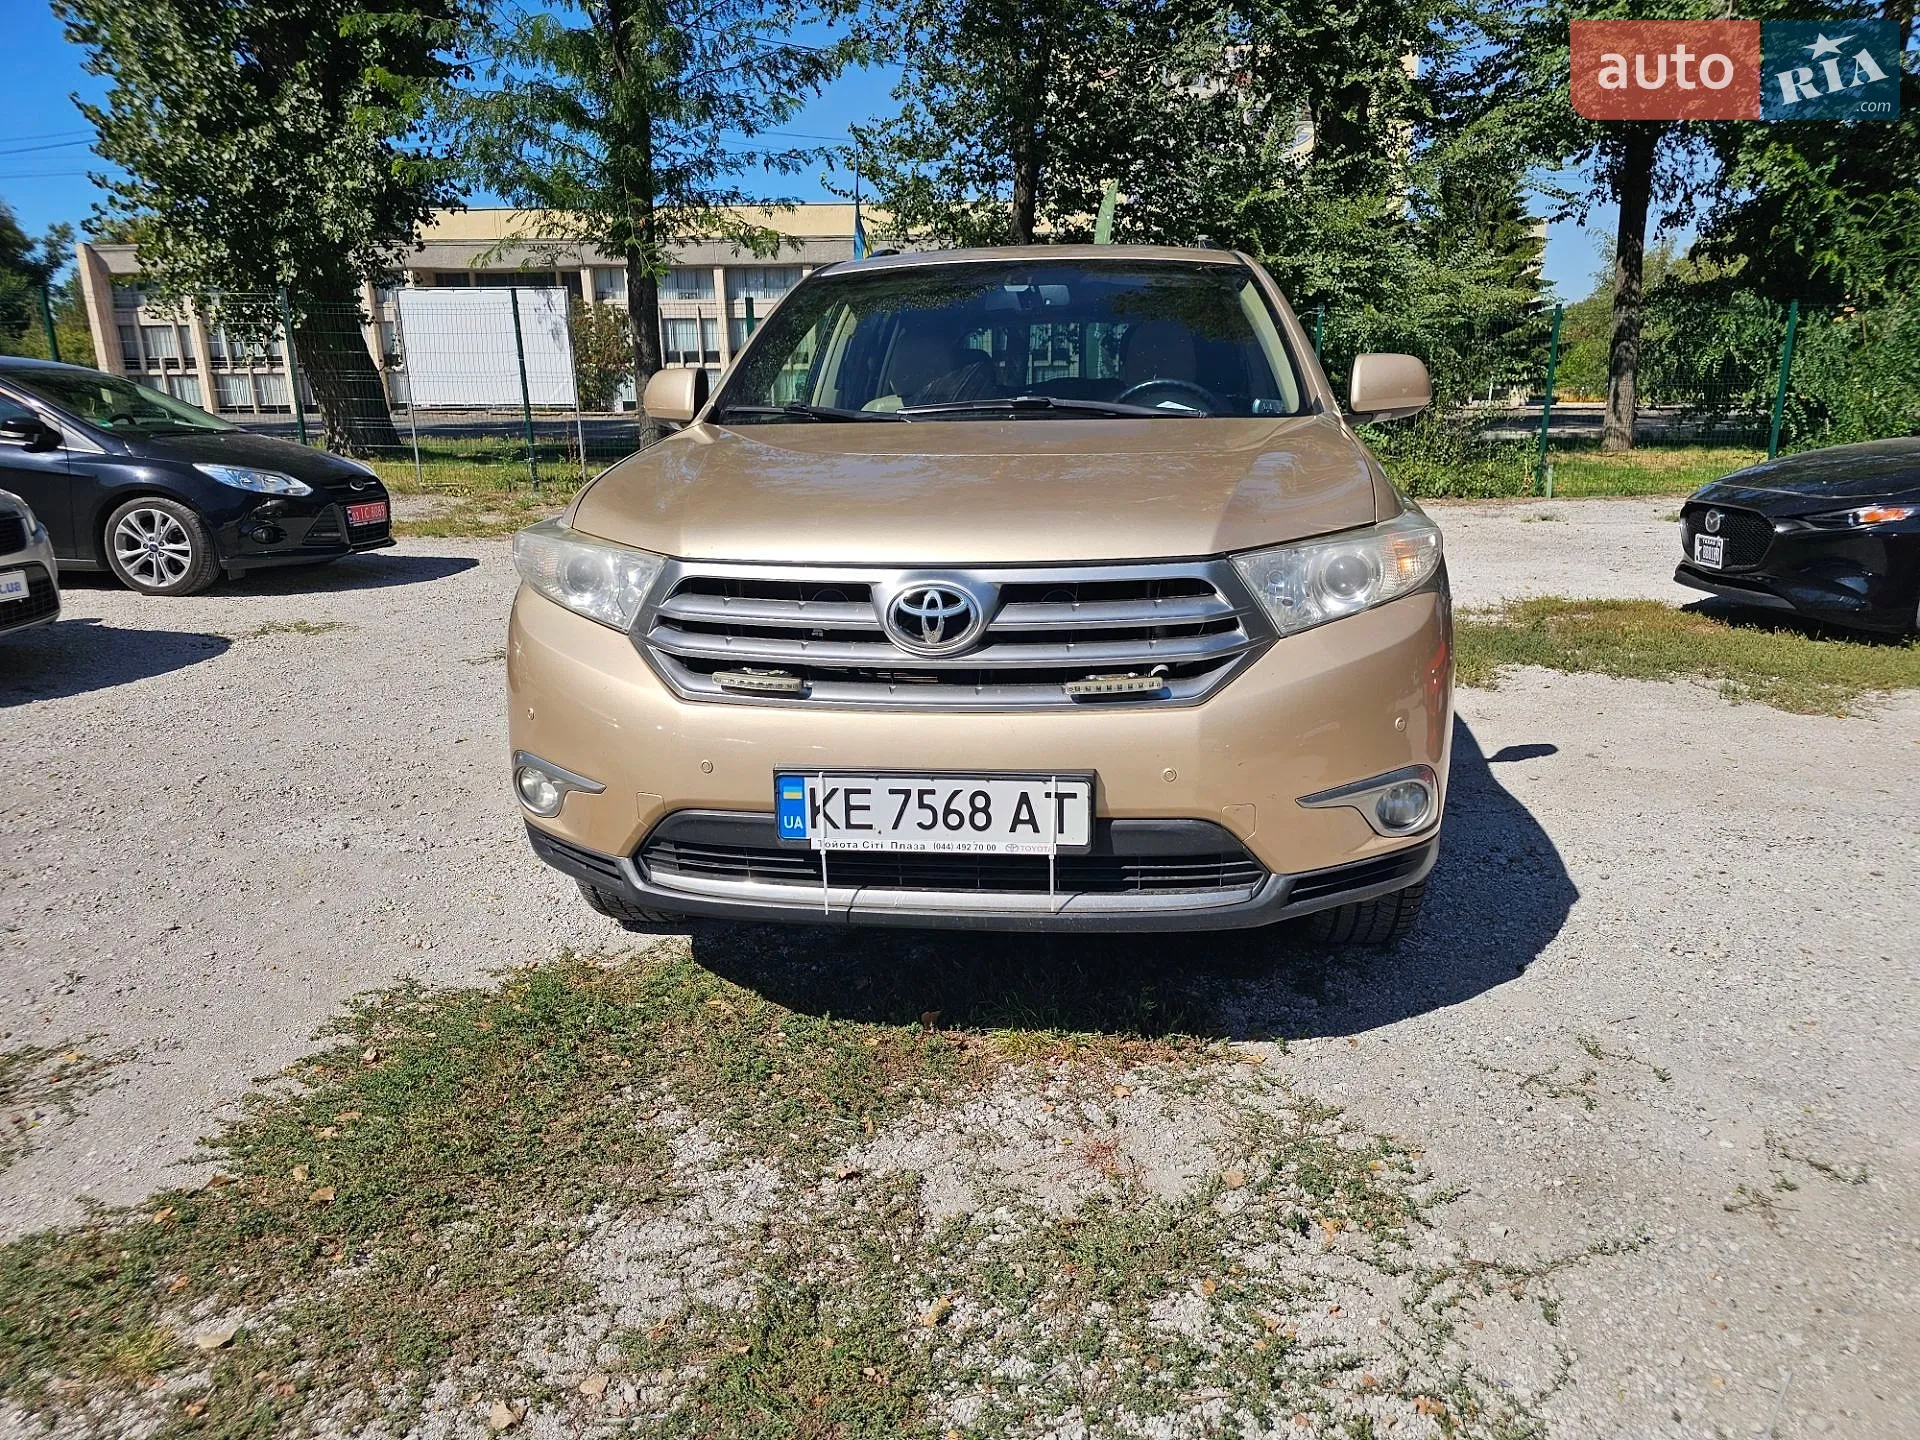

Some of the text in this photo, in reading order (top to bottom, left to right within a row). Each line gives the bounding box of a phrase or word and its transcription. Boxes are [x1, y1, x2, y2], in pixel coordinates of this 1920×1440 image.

[809, 787, 1078, 835] KE 7568 AT
[783, 815, 804, 829] UA
[890, 841, 926, 850] Плаза
[933, 842, 954, 851] (044)
[956, 843, 972, 852] 492
[974, 843, 984, 851] 70
[986, 843, 997, 851] 00
